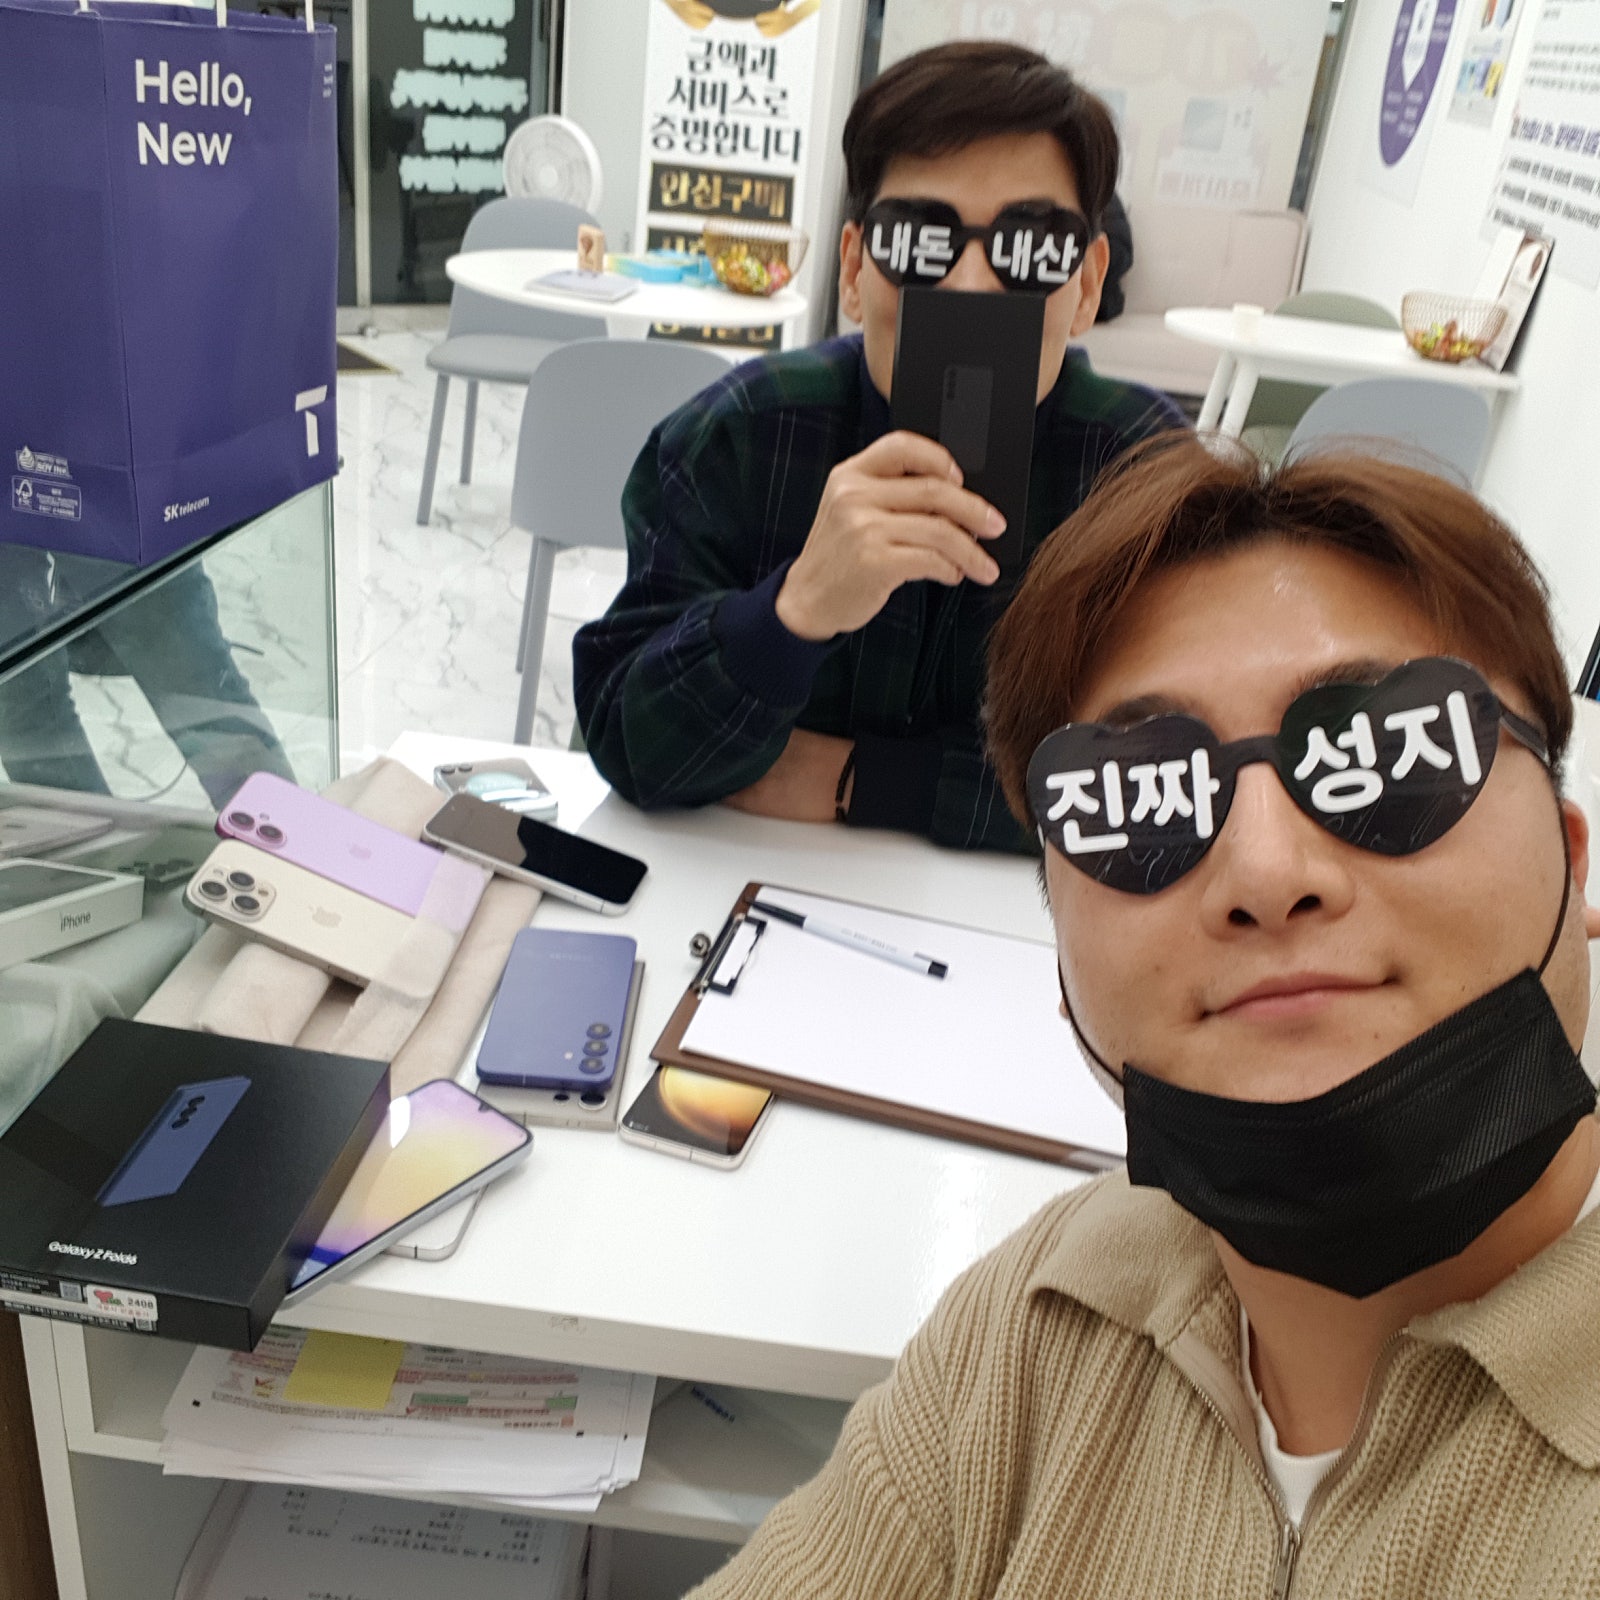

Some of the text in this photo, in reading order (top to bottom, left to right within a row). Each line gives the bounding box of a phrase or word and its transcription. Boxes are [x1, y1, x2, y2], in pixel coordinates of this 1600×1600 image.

[687, 36, 777, 81] 금액과
[135, 58, 252, 117] Hello,
[668, 77, 789, 119] 서비스로
[137, 121, 233, 166] New
[660, 170, 786, 218] 안심구매
[871, 221, 1079, 283] 내돈 내산
[163, 496, 210, 523] SK telecom
[1045, 690, 1483, 855] 진짜 성지
[60, 911, 92, 933] iPhone
[48, 1241, 95, 1259] Galaxy
